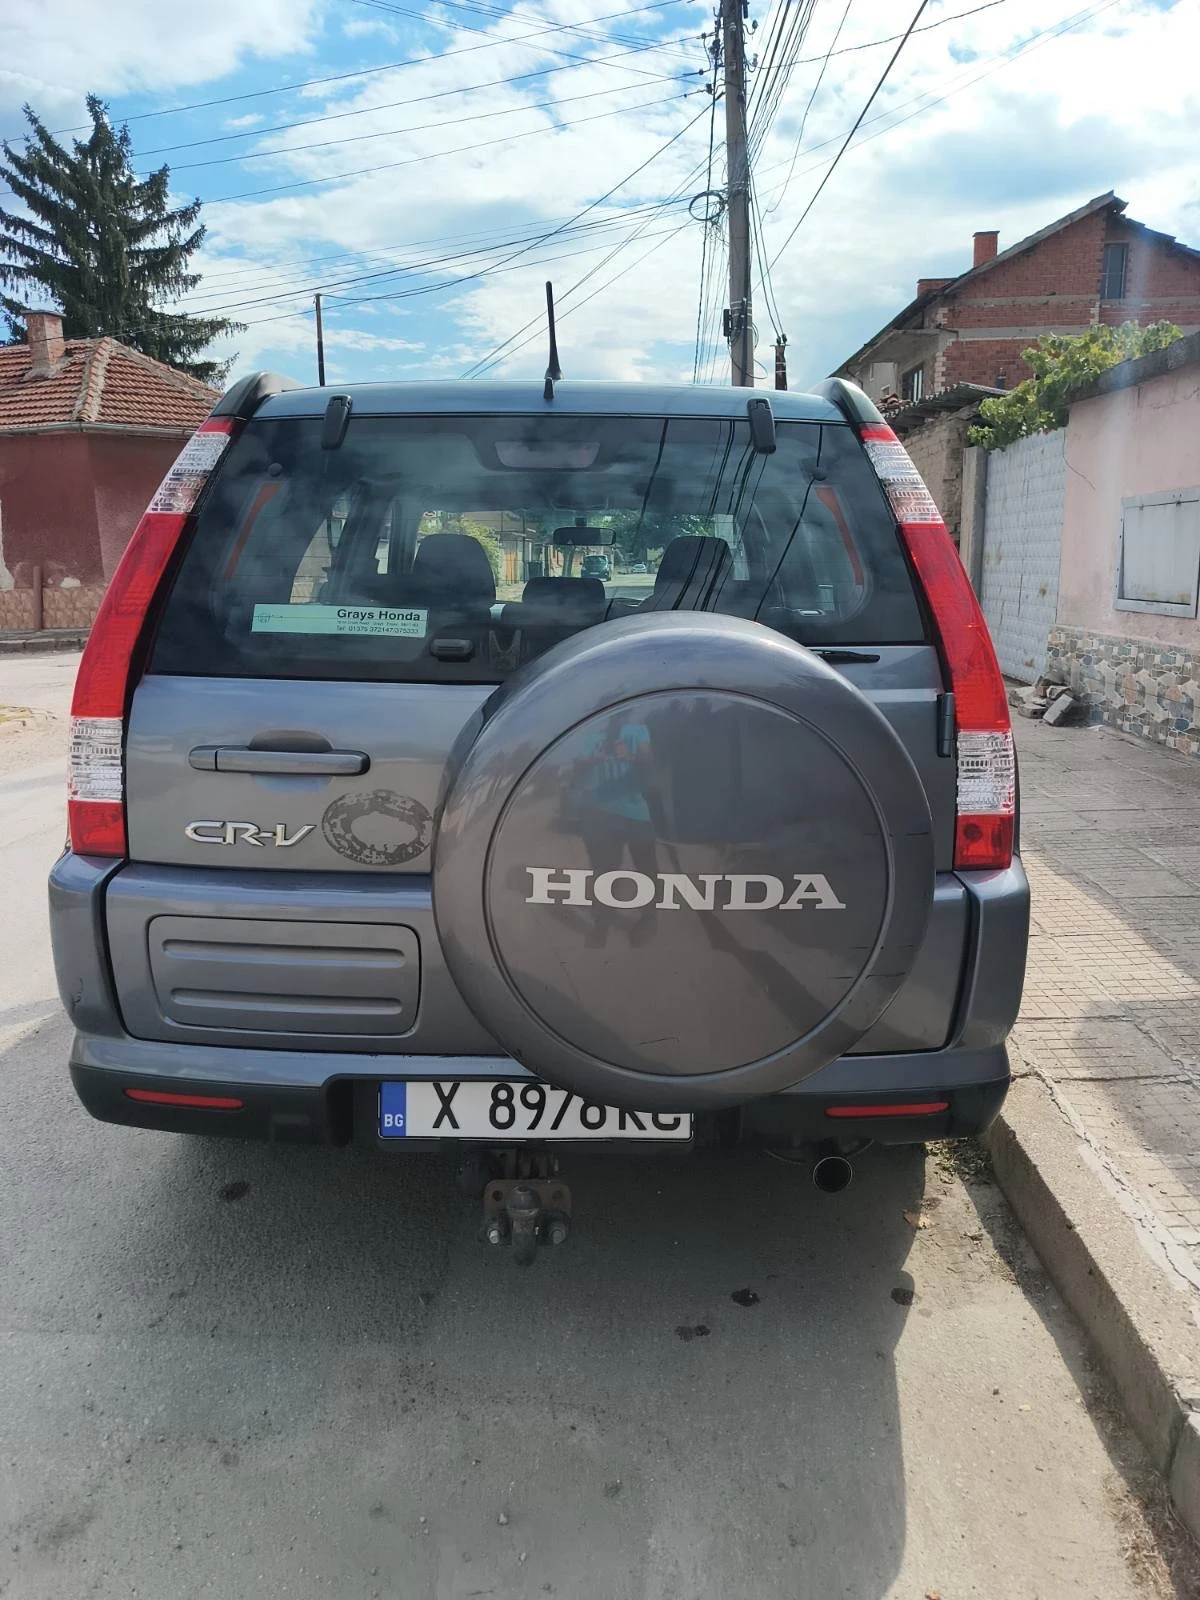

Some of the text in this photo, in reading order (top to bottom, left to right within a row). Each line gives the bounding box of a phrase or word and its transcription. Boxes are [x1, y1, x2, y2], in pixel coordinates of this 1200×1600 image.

[337, 609, 420, 621] Grays Honda
[185, 820, 318, 847] CR-V
[525, 866, 847, 910] HONDA
[432, 1082, 460, 1129] X
[384, 1114, 404, 1127] BG
